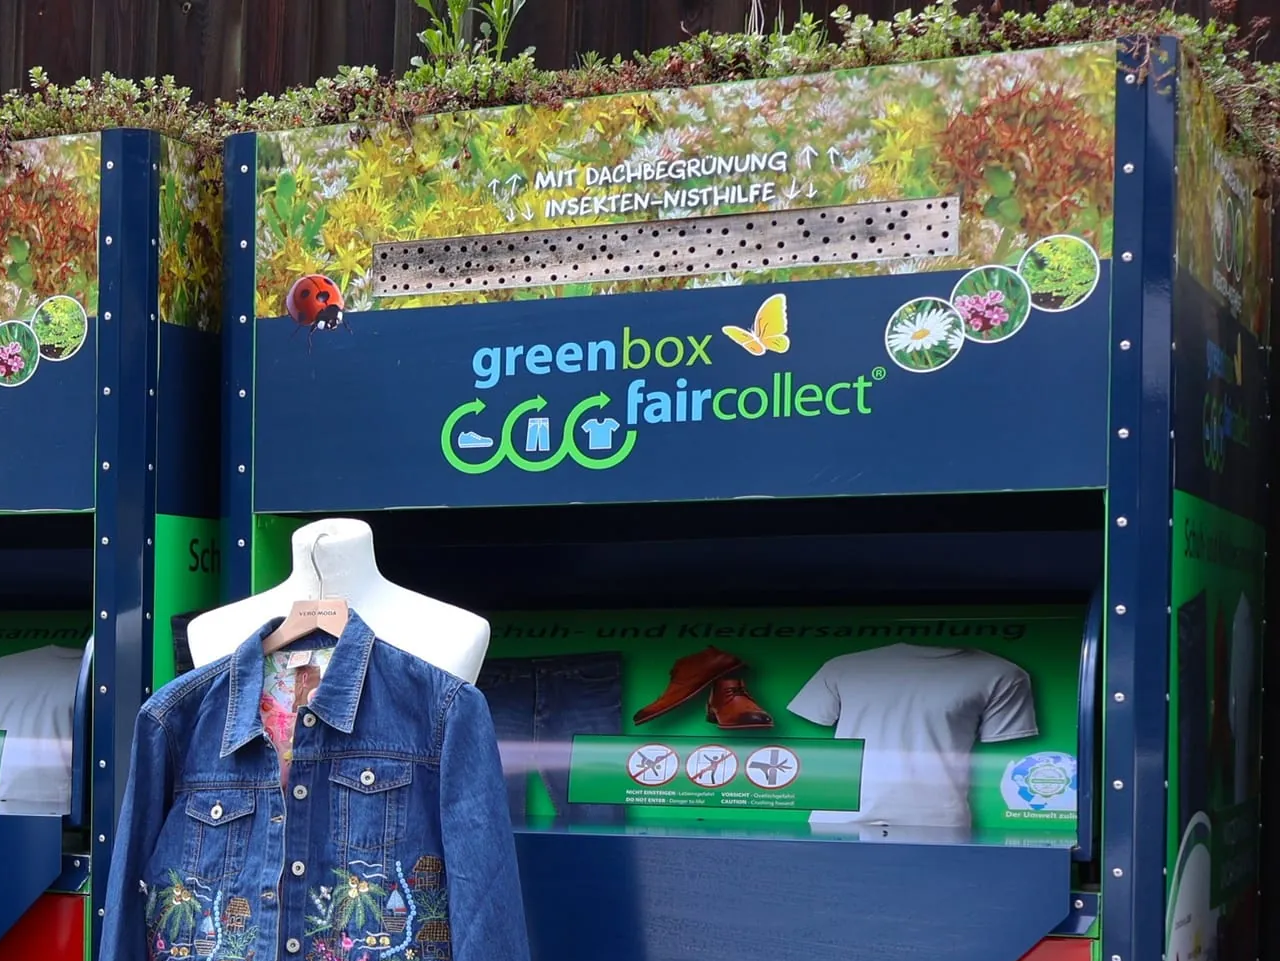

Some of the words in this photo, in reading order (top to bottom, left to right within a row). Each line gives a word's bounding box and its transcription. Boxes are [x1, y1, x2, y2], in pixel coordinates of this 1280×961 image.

[535, 168, 578, 191] MIT
[585, 152, 788, 186] DACHBEGRÜNUNG
[544, 182, 776, 218] INSEKTEN-NISTHILFE
[472, 326, 713, 389] greenbox
[596, 622, 666, 640] und
[677, 621, 1029, 643] Kleidersammlung
